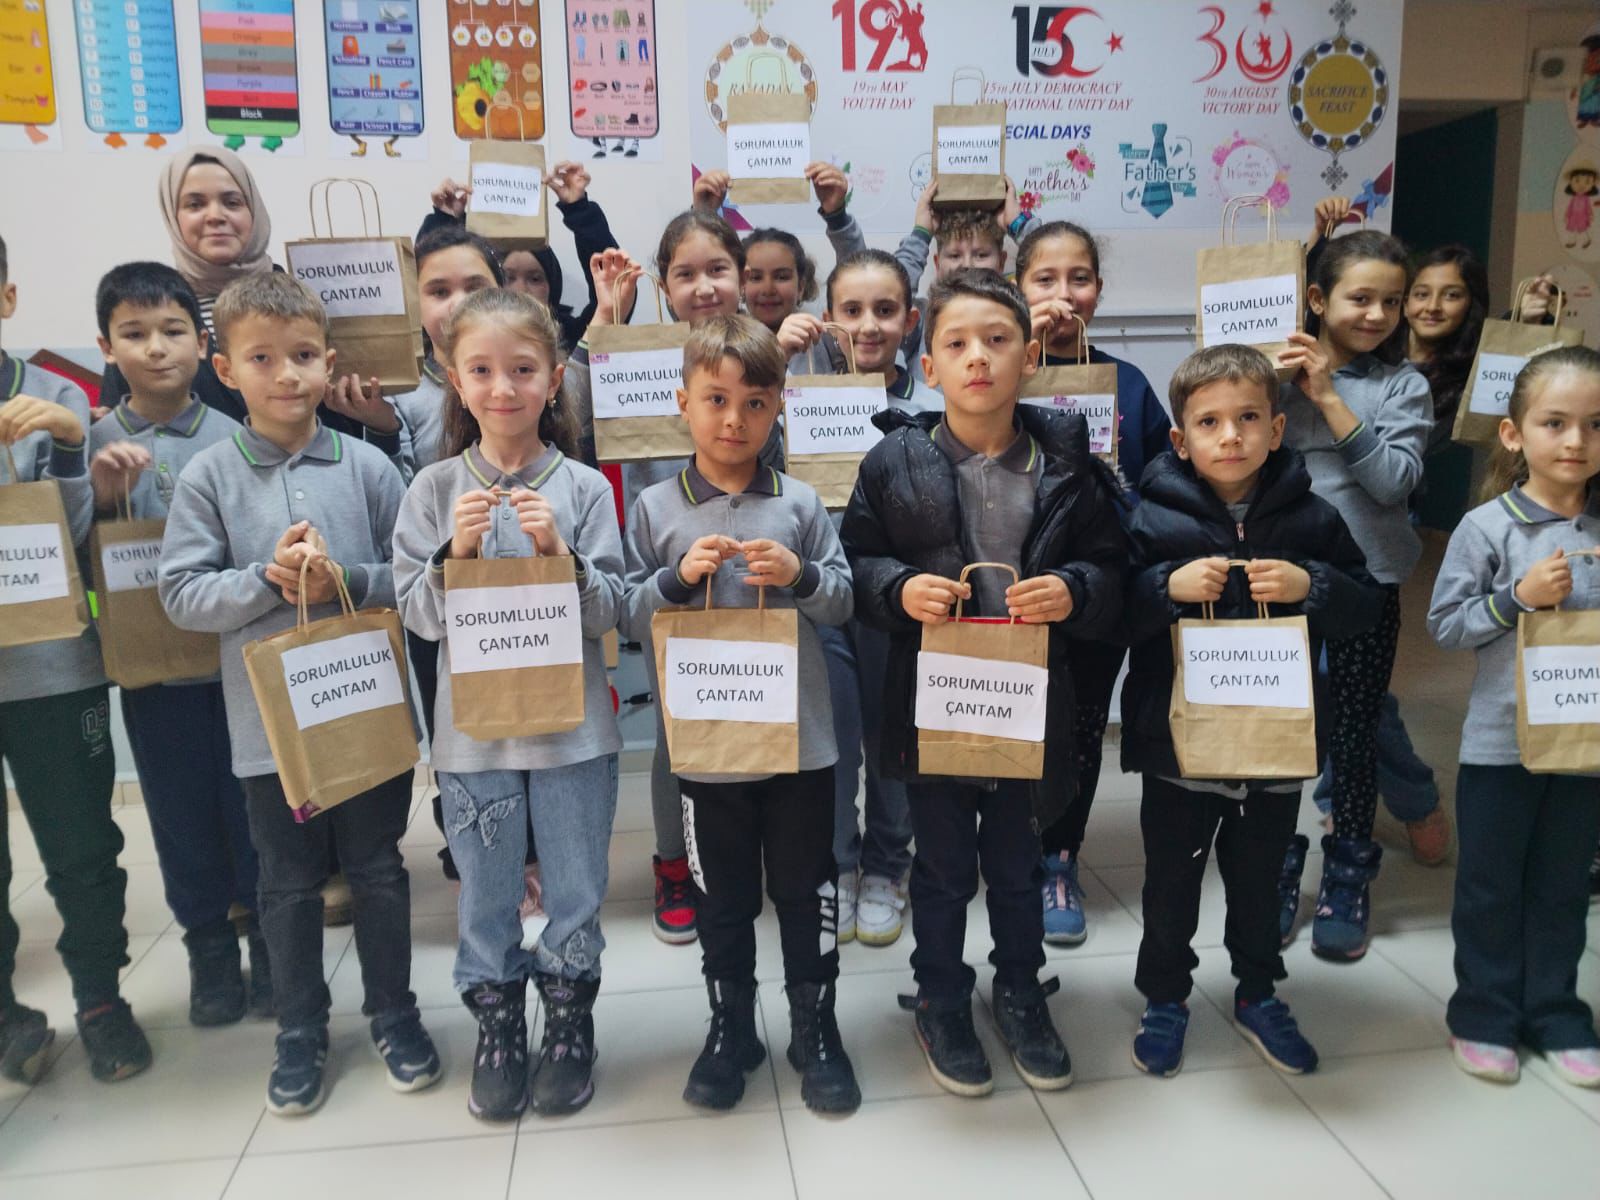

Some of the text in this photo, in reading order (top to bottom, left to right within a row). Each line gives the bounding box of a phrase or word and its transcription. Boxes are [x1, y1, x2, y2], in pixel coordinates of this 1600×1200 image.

[880, 81, 908, 93] MAY
[1009, 81, 1041, 94] JULY
[1044, 81, 1123, 94] DEMOCRACY
[1230, 87, 1279, 98] AUGUST
[1309, 86, 1369, 98] SACRIFICE
[842, 97, 916, 110] YOUTH DAY
[1067, 98, 1106, 111] UNITY
[1108, 98, 1134, 111] DAY
[1202, 103, 1281, 114] VICTORY DAY
[1320, 102, 1356, 113] FEAST
[240, 107, 262, 119] Black
[1051, 124, 1092, 140] DAYS
[735, 139, 804, 151] SORUMLULUK
[937, 139, 1000, 149] SORUMLULUK
[747, 157, 792, 169] ÇANTAM
[948, 155, 988, 166] ÇANTAM
[1124, 162, 1197, 181] Father's
[473, 178, 539, 192] SORUMLULUK
[1023, 168, 1090, 191] mother's
[296, 260, 396, 280] SORUMLULUK
[320, 286, 382, 305] ÇANTAM
[1204, 294, 1294, 315] SORUMLULUK
[1221, 317, 1278, 335] ÇANTAM
[599, 368, 682, 385] SORUMLULU
[617, 390, 673, 406] ÇANTAM
[793, 404, 879, 418] SORUMLULUK
[810, 426, 864, 440] ÇANTAM
[455, 605, 567, 627] SORUMLULUK
[479, 633, 549, 655] ÇANTAM
[1189, 649, 1300, 663] SORUMLULUK
[289, 648, 392, 687] SORUMLULUK
[677, 662, 784, 677] SORUMLULUK
[927, 674, 1035, 697] SORUMLULUK
[1210, 674, 1280, 689] ÇANTAM
[311, 678, 377, 708] ÇANTAM
[696, 688, 764, 704] ÇANTAM
[945, 701, 1012, 719] ÇANTAM
